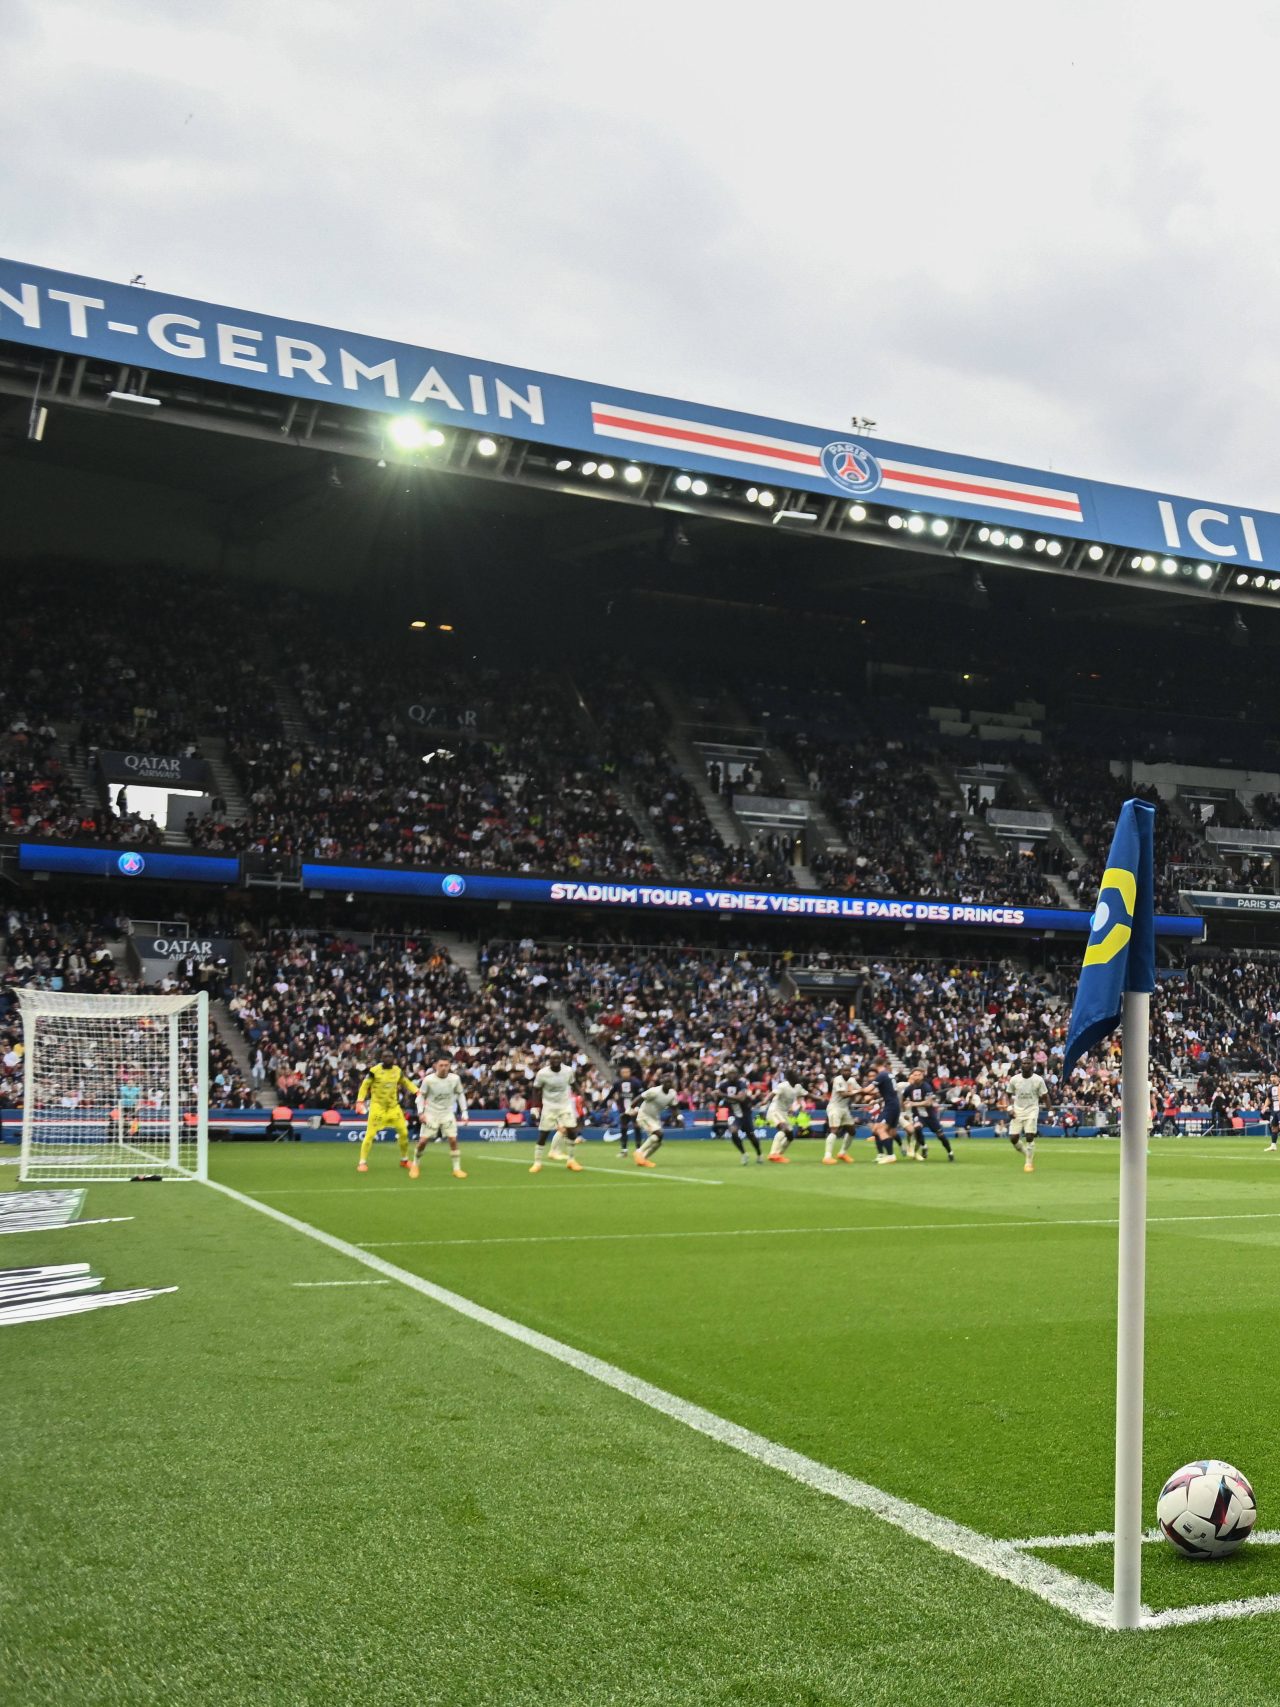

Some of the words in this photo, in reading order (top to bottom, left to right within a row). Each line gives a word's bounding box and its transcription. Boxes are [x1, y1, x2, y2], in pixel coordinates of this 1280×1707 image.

[829, 444, 868, 460] PARIS
[1157, 500, 1264, 562] ICI
[125, 755, 181, 771] QATAR
[550, 883, 638, 904] STADIUM
[639, 888, 693, 906] TOUR
[705, 892, 768, 911] VENEZ
[769, 896, 840, 914] VISITER
[841, 900, 864, 916] LE
[866, 901, 914, 919] PARC
[915, 905, 950, 921] DES
[952, 907, 1025, 925] PRINCES
[1237, 899, 1267, 909] PARIS
[153, 939, 213, 955] QATAR
[480, 1127, 517, 1139] QATAR
